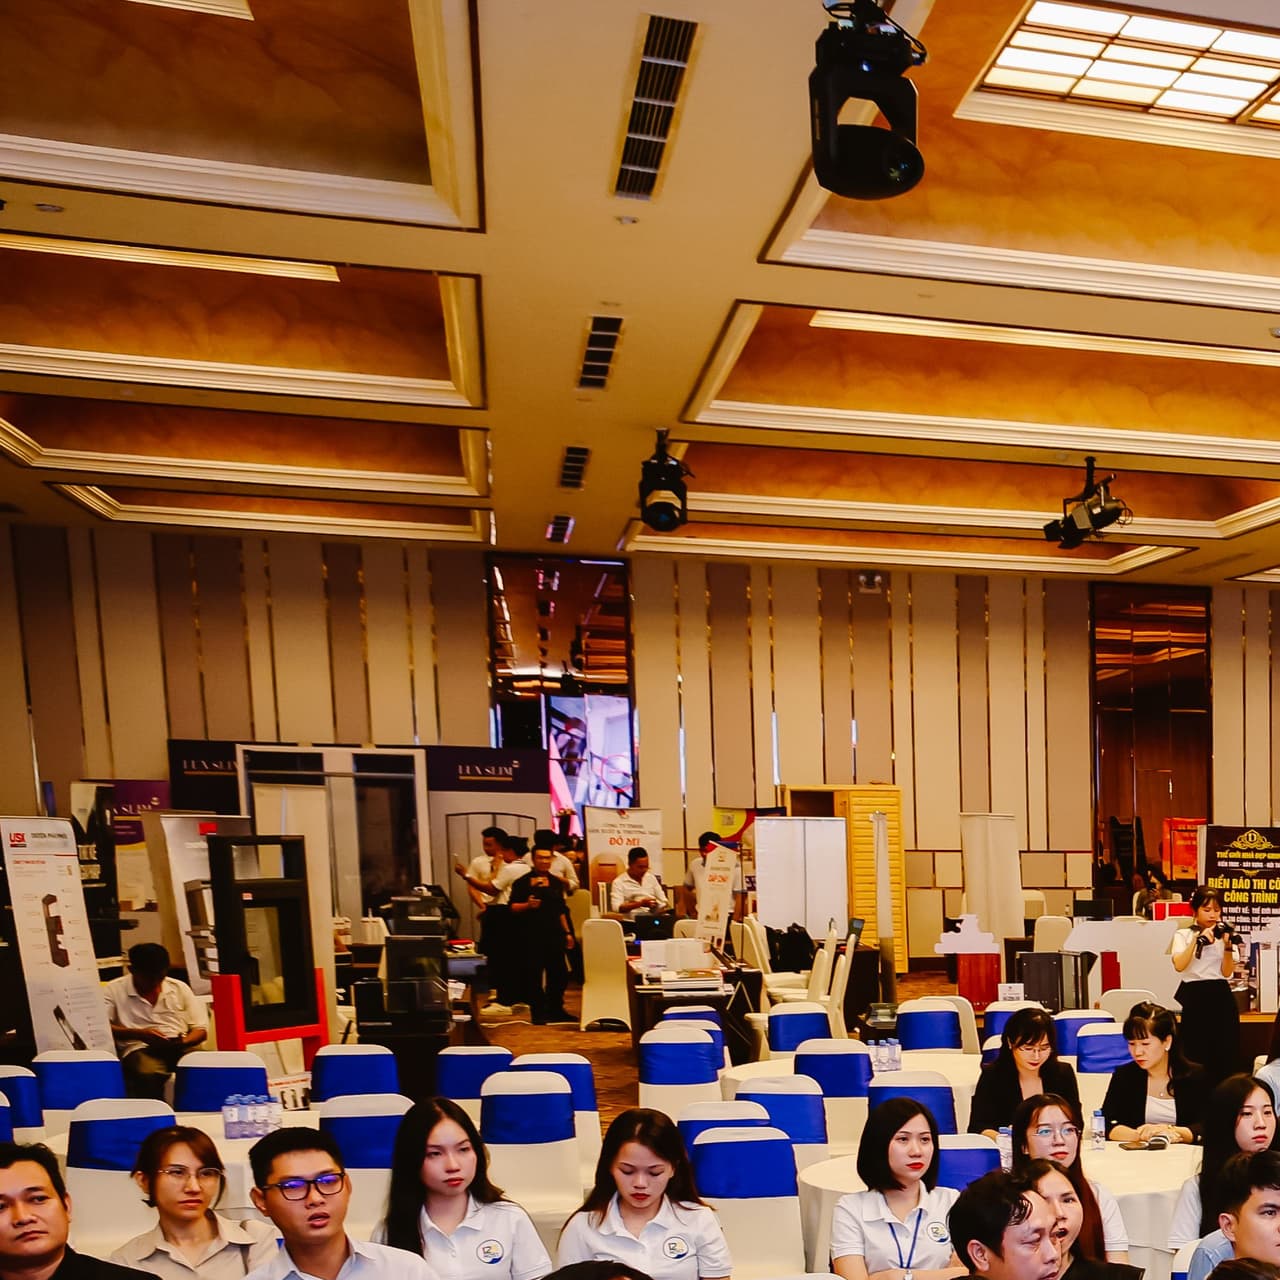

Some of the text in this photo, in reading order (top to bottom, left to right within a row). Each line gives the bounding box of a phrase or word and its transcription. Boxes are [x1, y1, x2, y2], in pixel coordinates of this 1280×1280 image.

[1207, 874, 1231, 889] BIỂN
[1231, 876, 1251, 890] BÁO
[1252, 878, 1267, 890] THI
[1223, 890, 1278, 904] CÔNG TRÌNH
